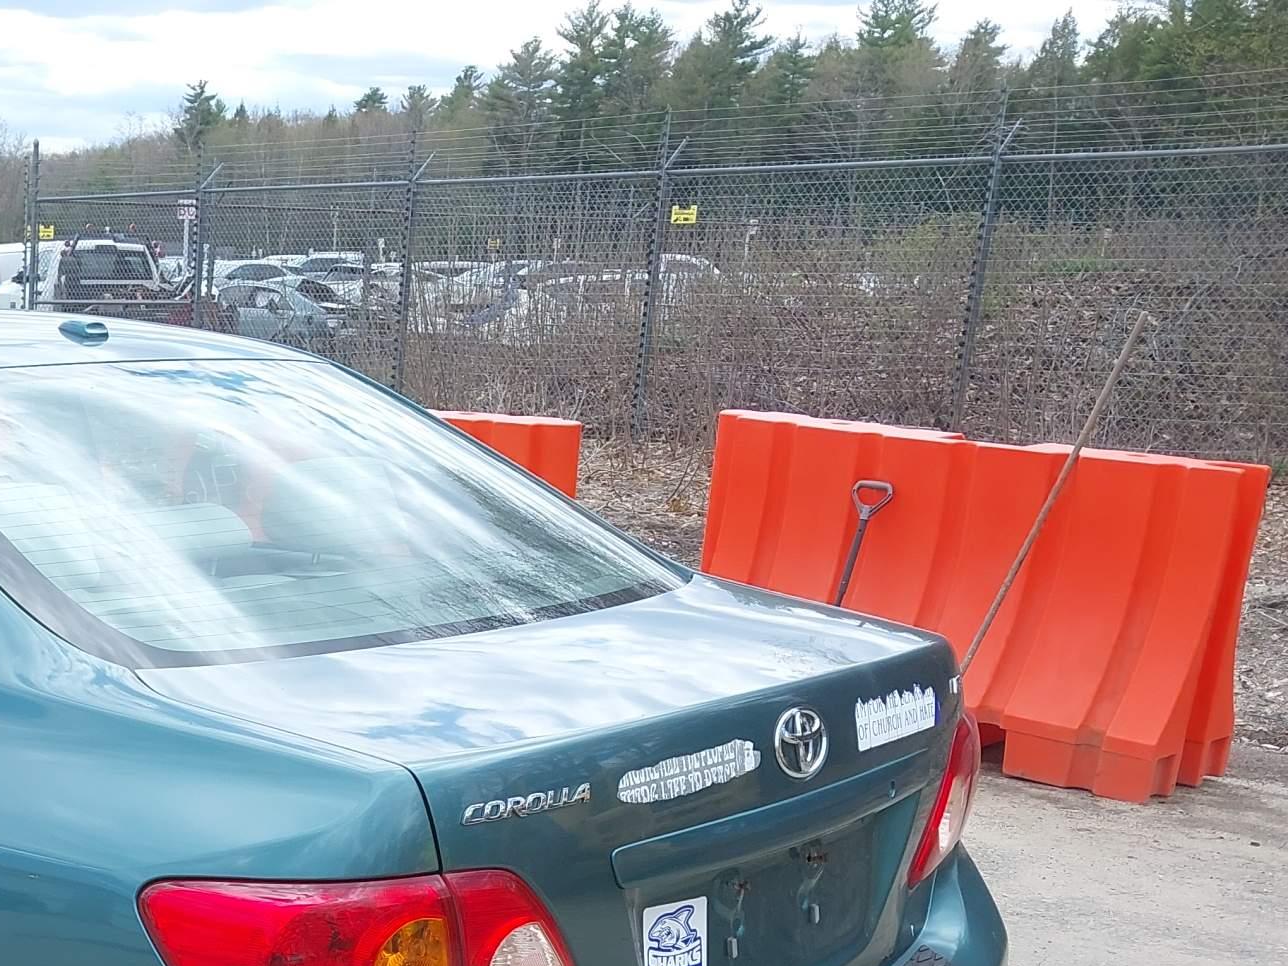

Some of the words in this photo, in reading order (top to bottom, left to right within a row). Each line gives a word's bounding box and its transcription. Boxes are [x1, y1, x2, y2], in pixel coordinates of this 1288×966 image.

[858, 723, 869, 741] OF
[871, 713, 902, 737] CHURCH
[904, 708, 918, 727] AND
[461, 782, 591, 825] COROLLA
